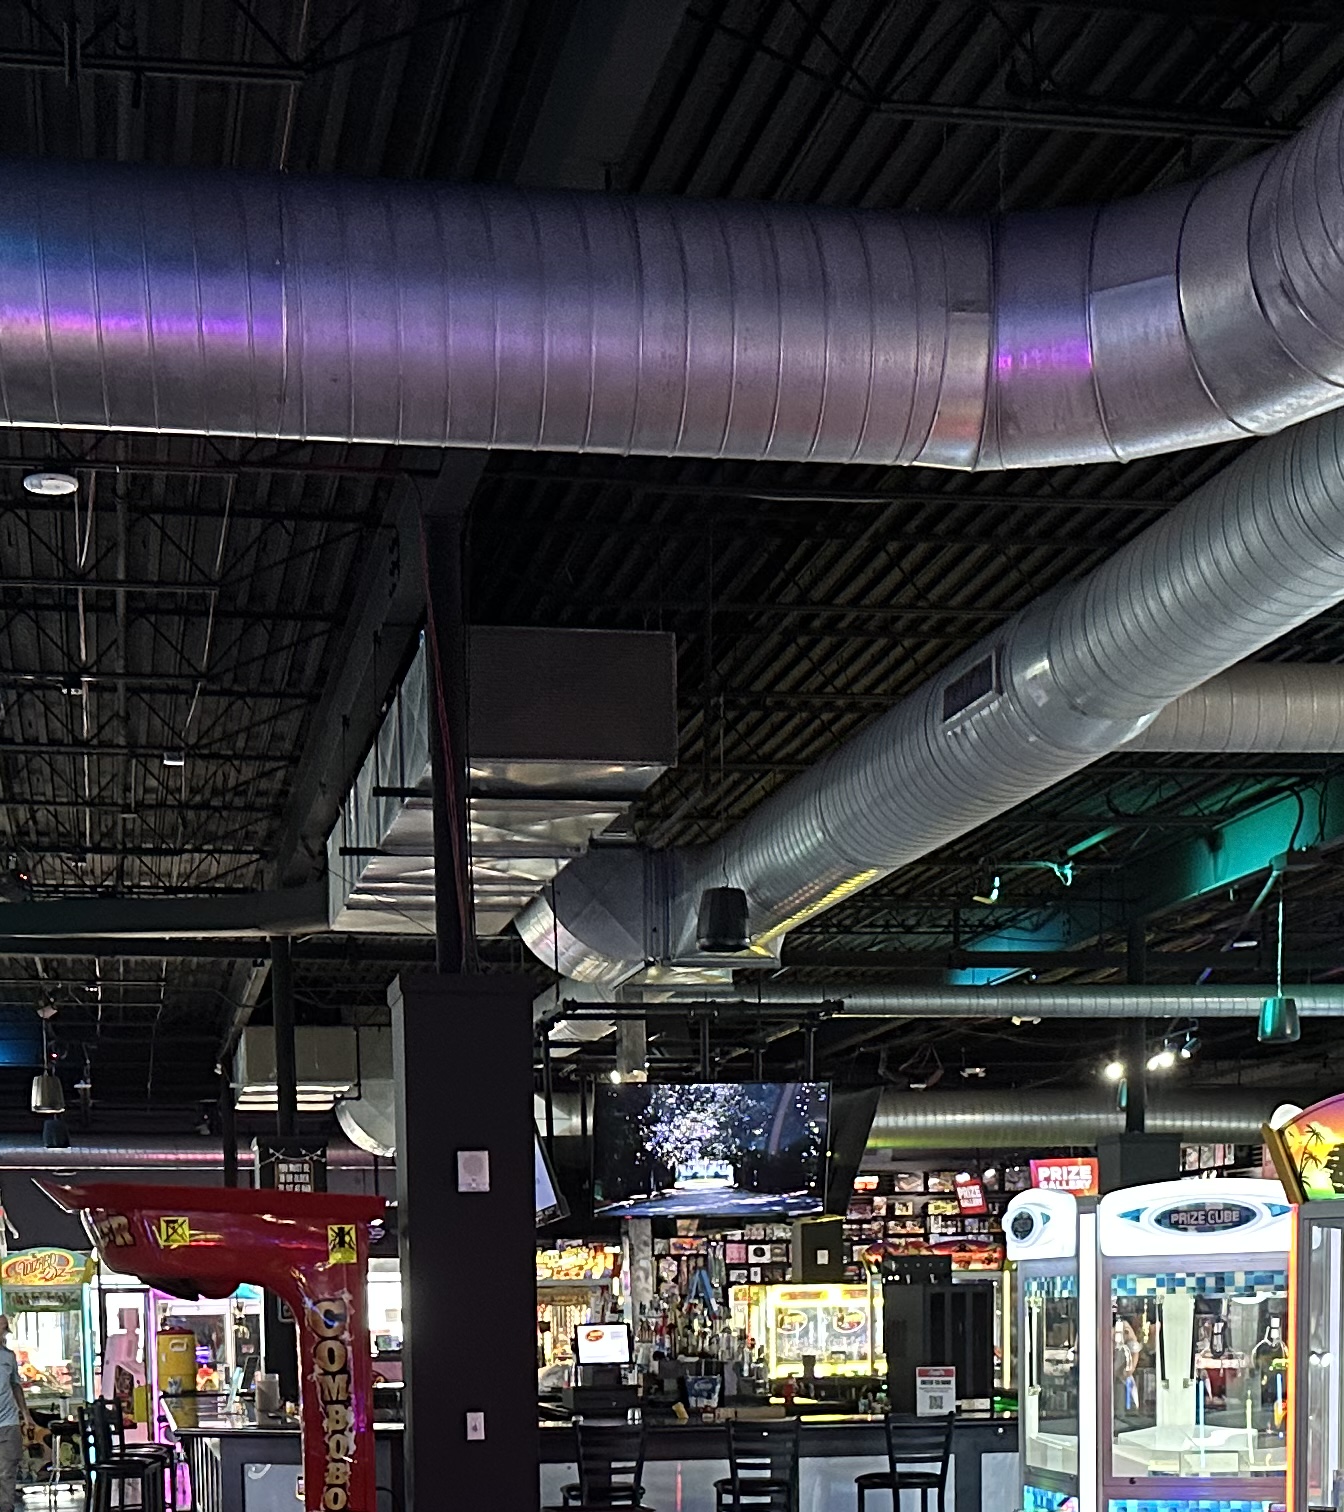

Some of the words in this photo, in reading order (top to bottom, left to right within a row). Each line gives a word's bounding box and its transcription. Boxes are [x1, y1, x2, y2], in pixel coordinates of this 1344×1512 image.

[1038, 1165, 1092, 1180] PRIZE
[957, 1185, 982, 1199] PRIZE
[1170, 1211, 1206, 1225] PRIZE
[1207, 1210, 1240, 1224] CUBE
